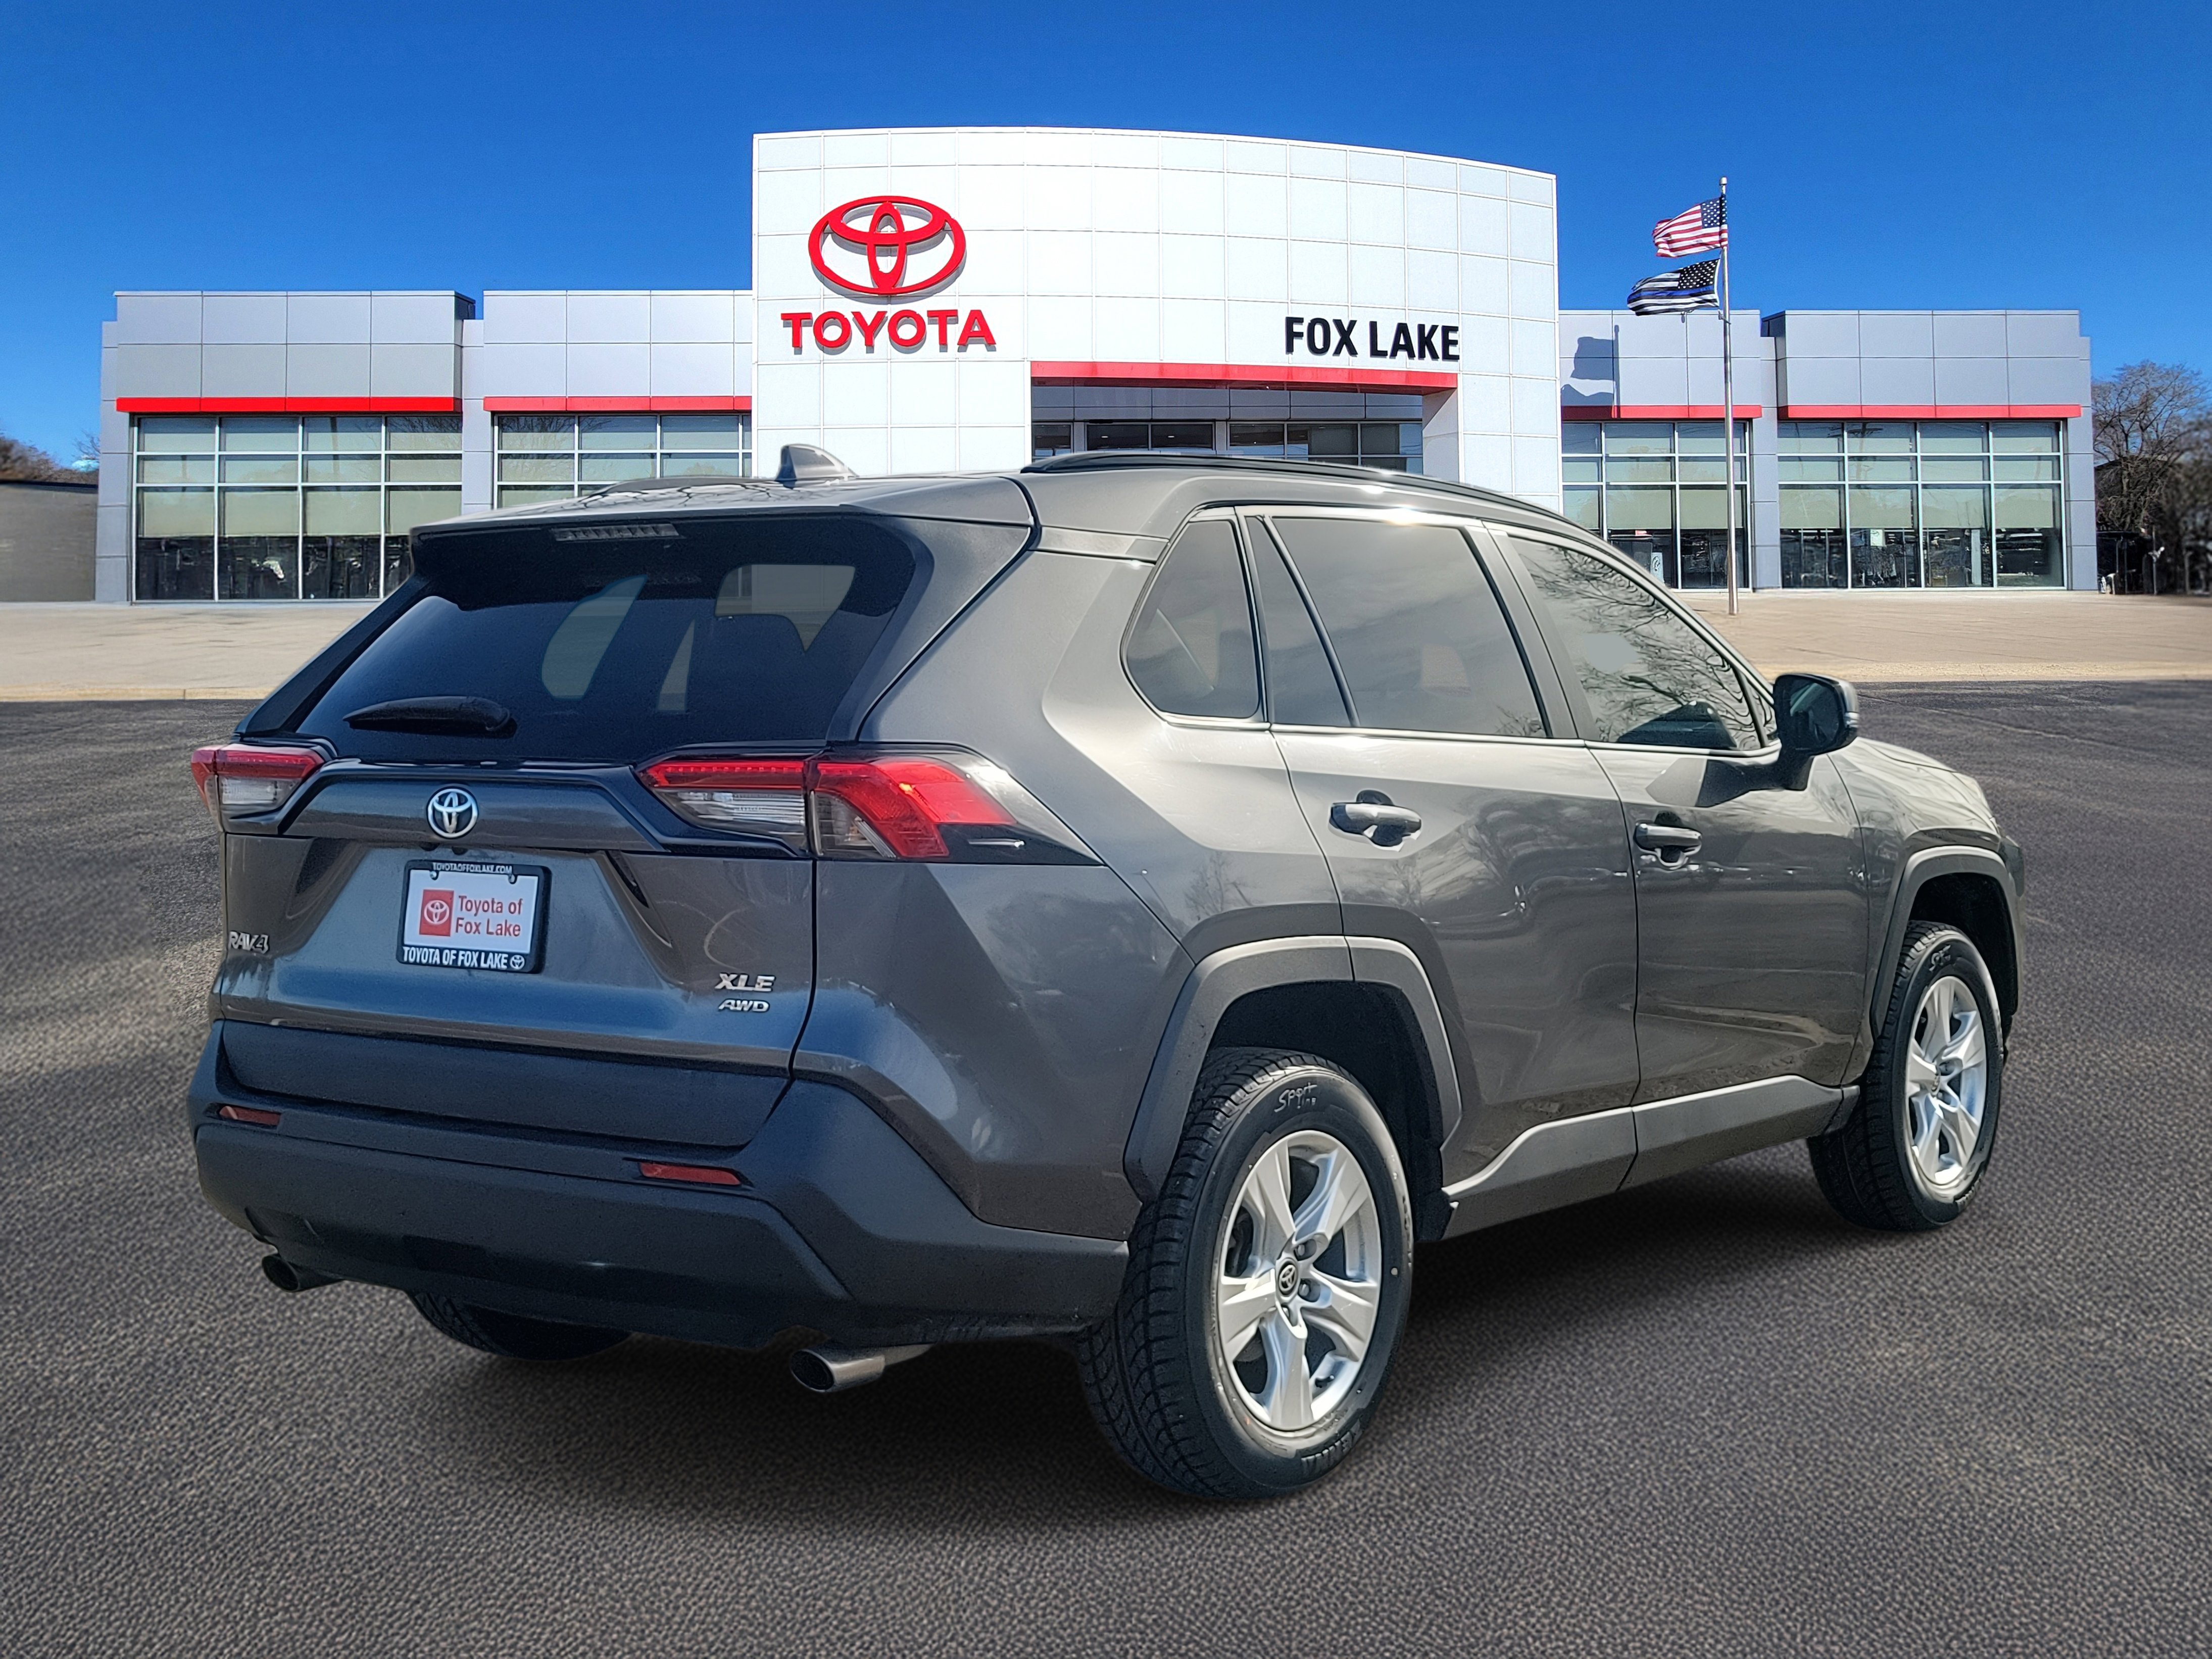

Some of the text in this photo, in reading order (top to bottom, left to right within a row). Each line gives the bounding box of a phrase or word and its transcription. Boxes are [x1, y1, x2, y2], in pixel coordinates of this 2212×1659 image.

[781, 309, 997, 349] TOYOTA
[1285, 316, 1460, 361] FOX LAKE
[459, 895, 523, 916] Toyota of
[455, 917, 521, 937] Fox Lake
[403, 946, 509, 969] TOYOTA OF FOX LAKE
[714, 973, 775, 992] XLE
[718, 999, 770, 1012] AWD
